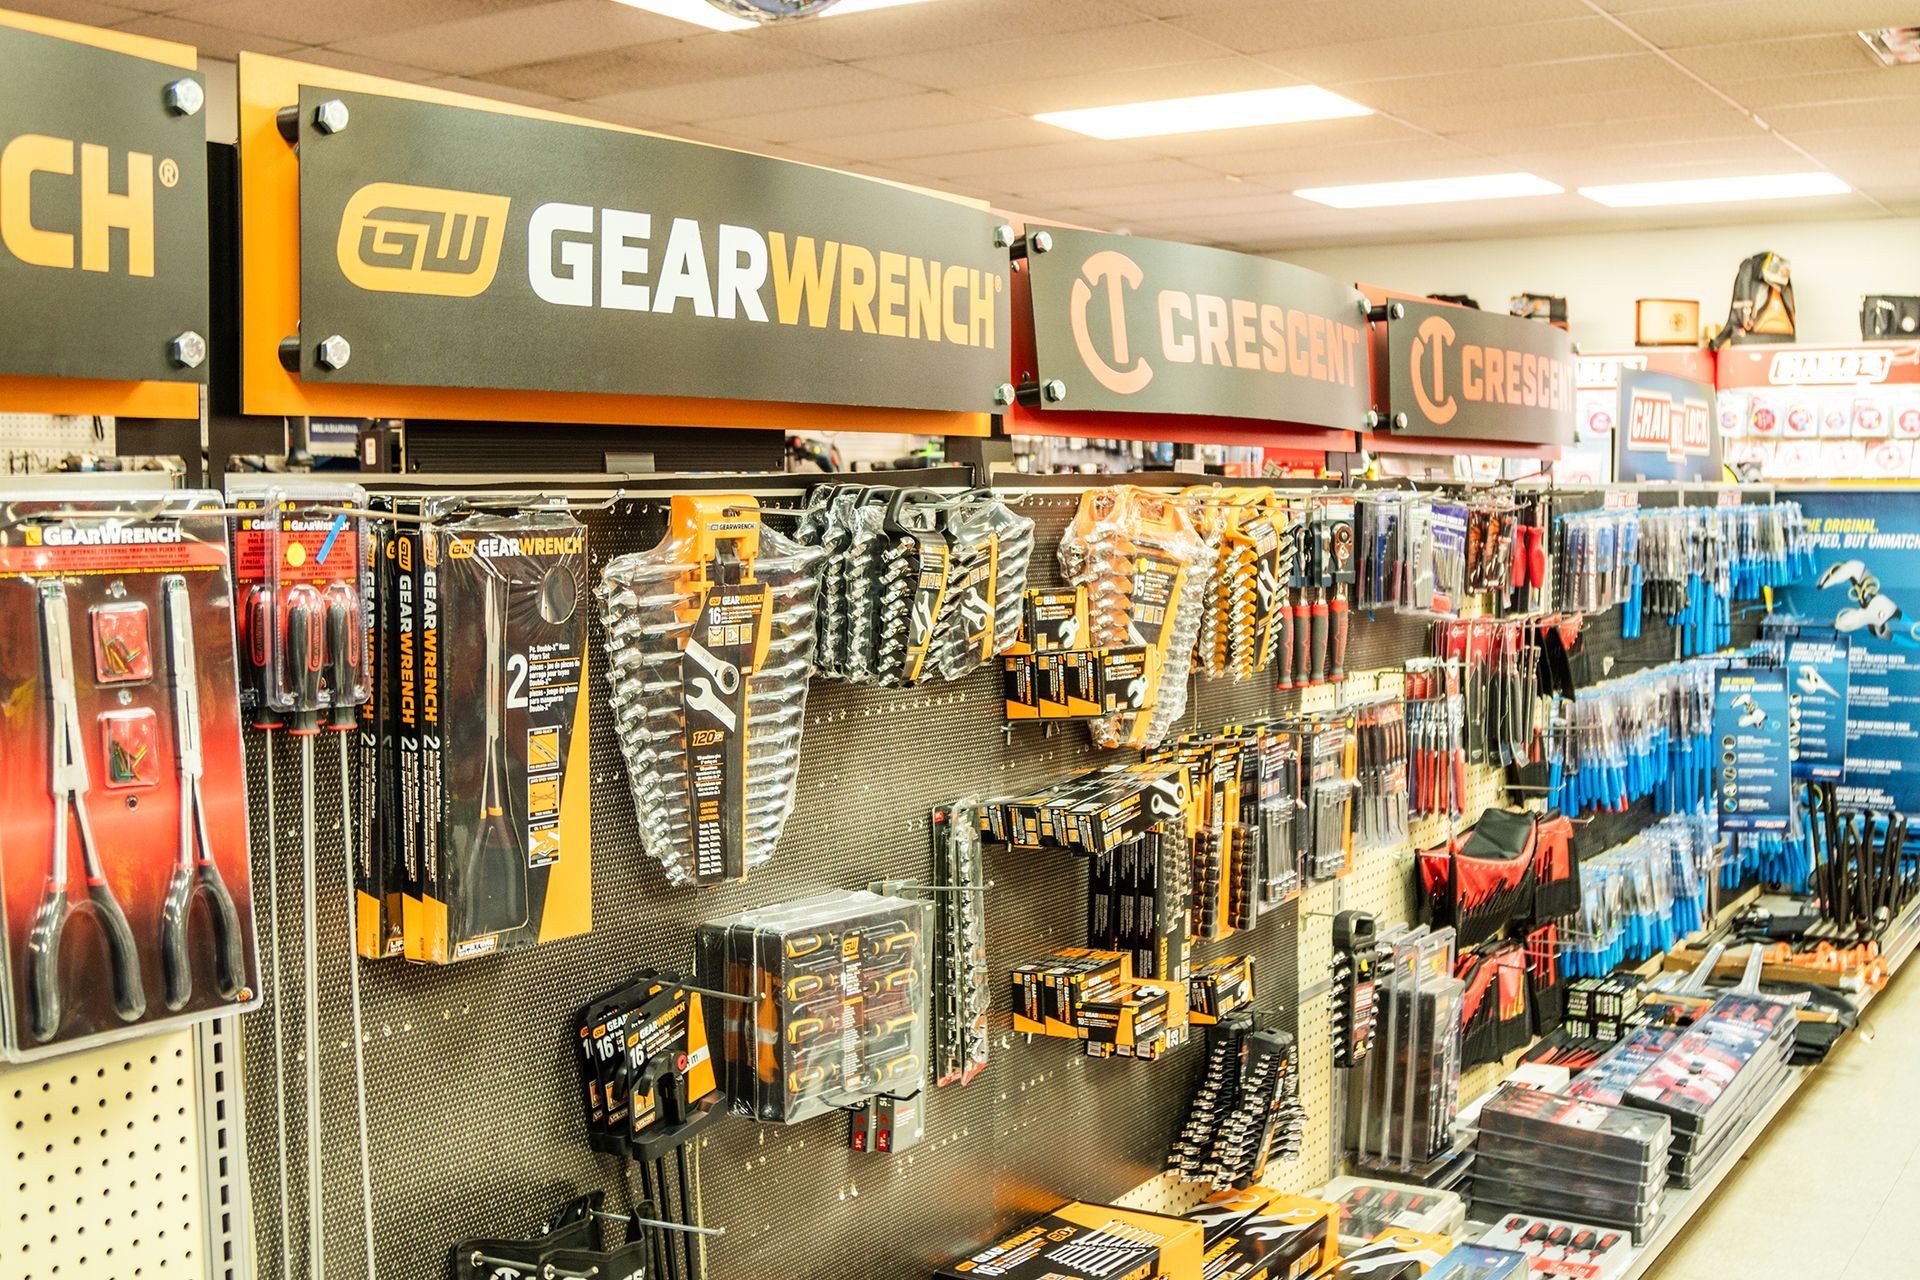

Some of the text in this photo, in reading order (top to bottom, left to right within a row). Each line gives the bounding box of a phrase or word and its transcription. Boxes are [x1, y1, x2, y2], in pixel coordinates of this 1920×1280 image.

[478, 536, 583, 557] GEARWRENCH
[1133, 574, 1145, 596] 15
[709, 607, 721, 624] 16
[400, 575, 414, 724] GEARWRENCH
[424, 572, 437, 722] GEARWRENCH
[506, 653, 529, 709] 2
[361, 732, 376, 747] 2
[402, 737, 418, 751] 2
[424, 736, 440, 750] 2
[639, 1001, 686, 1040] GEARWRENCH
[971, 1226, 1048, 1262] GEARWRENCH
